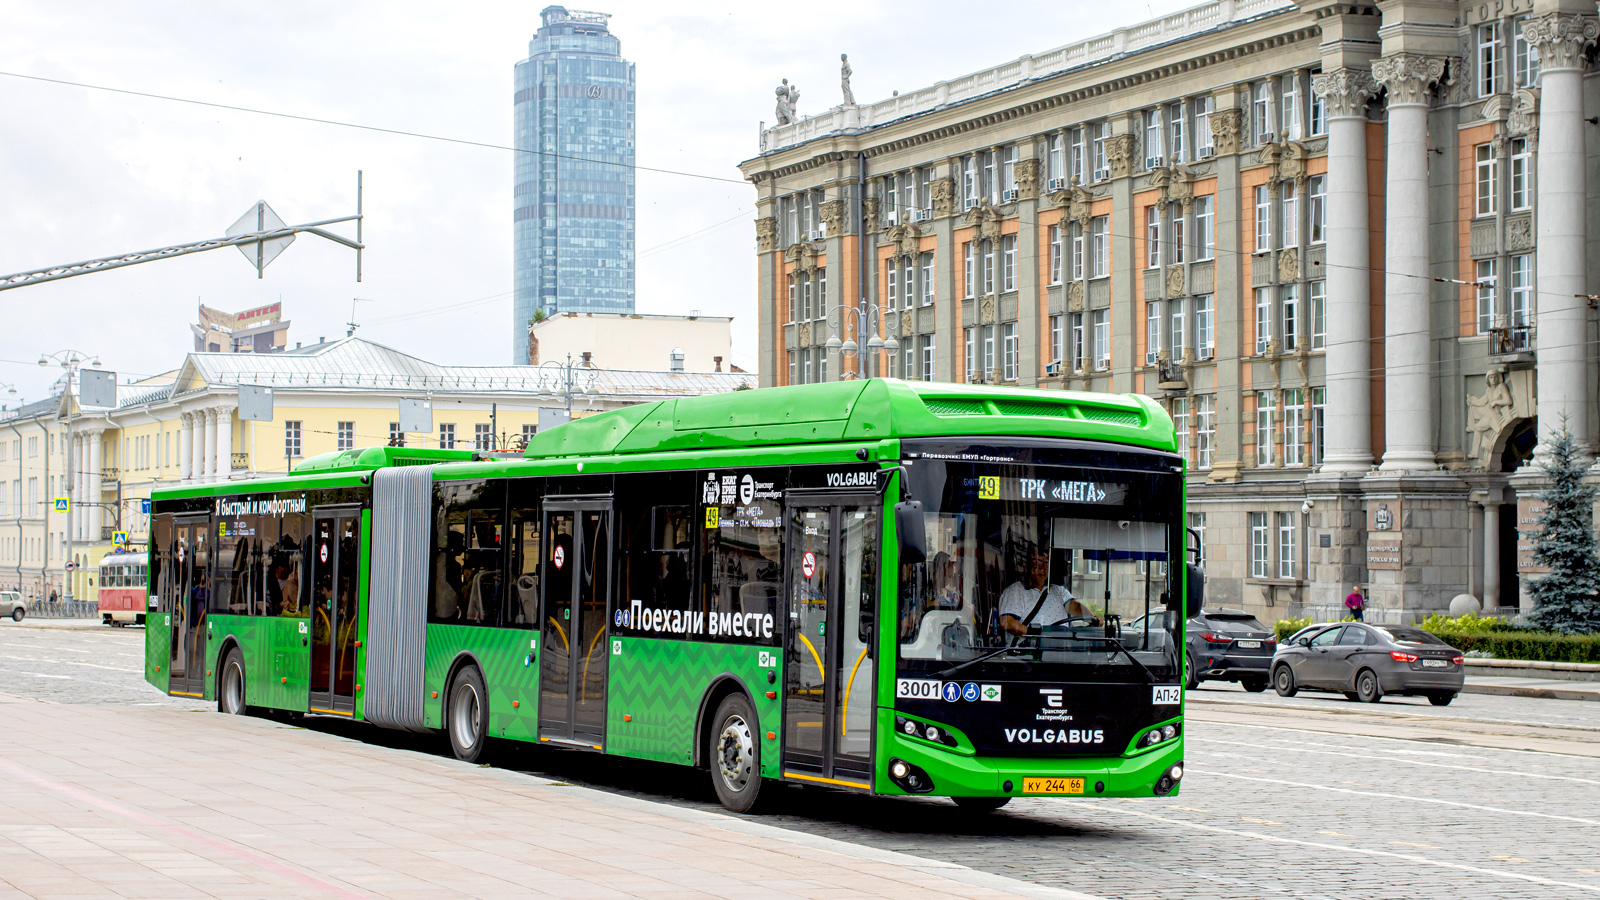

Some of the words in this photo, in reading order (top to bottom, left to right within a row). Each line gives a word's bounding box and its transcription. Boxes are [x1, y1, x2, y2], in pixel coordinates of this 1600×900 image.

[237, 304, 280, 321] АНТЕЙ
[922, 452, 961, 460] Перевозчик:
[722, 475, 737, 485] ЕКАТ
[721, 485, 737, 495] ЕРИН
[979, 477, 996, 497] 49
[1020, 478, 1046, 499] ТРК
[1052, 480, 1106, 502] «МЕГА»
[721, 494, 737, 505] БУРГ
[215, 498, 221, 516] Я
[221, 496, 252, 520] быстрый
[252, 500, 258, 514] и
[258, 493, 307, 519] комфортный
[630, 599, 704, 635] Поехали
[708, 611, 774, 639] вместе
[900, 681, 939, 697] 3001
[1155, 689, 1179, 702] АП-2
[1041, 707, 1068, 715] Транспорт
[1004, 728, 1104, 743] VOLGABUS
[1028, 781, 1041, 791] КУ
[1045, 780, 1065, 792] 244
[1070, 779, 1081, 789] 66
